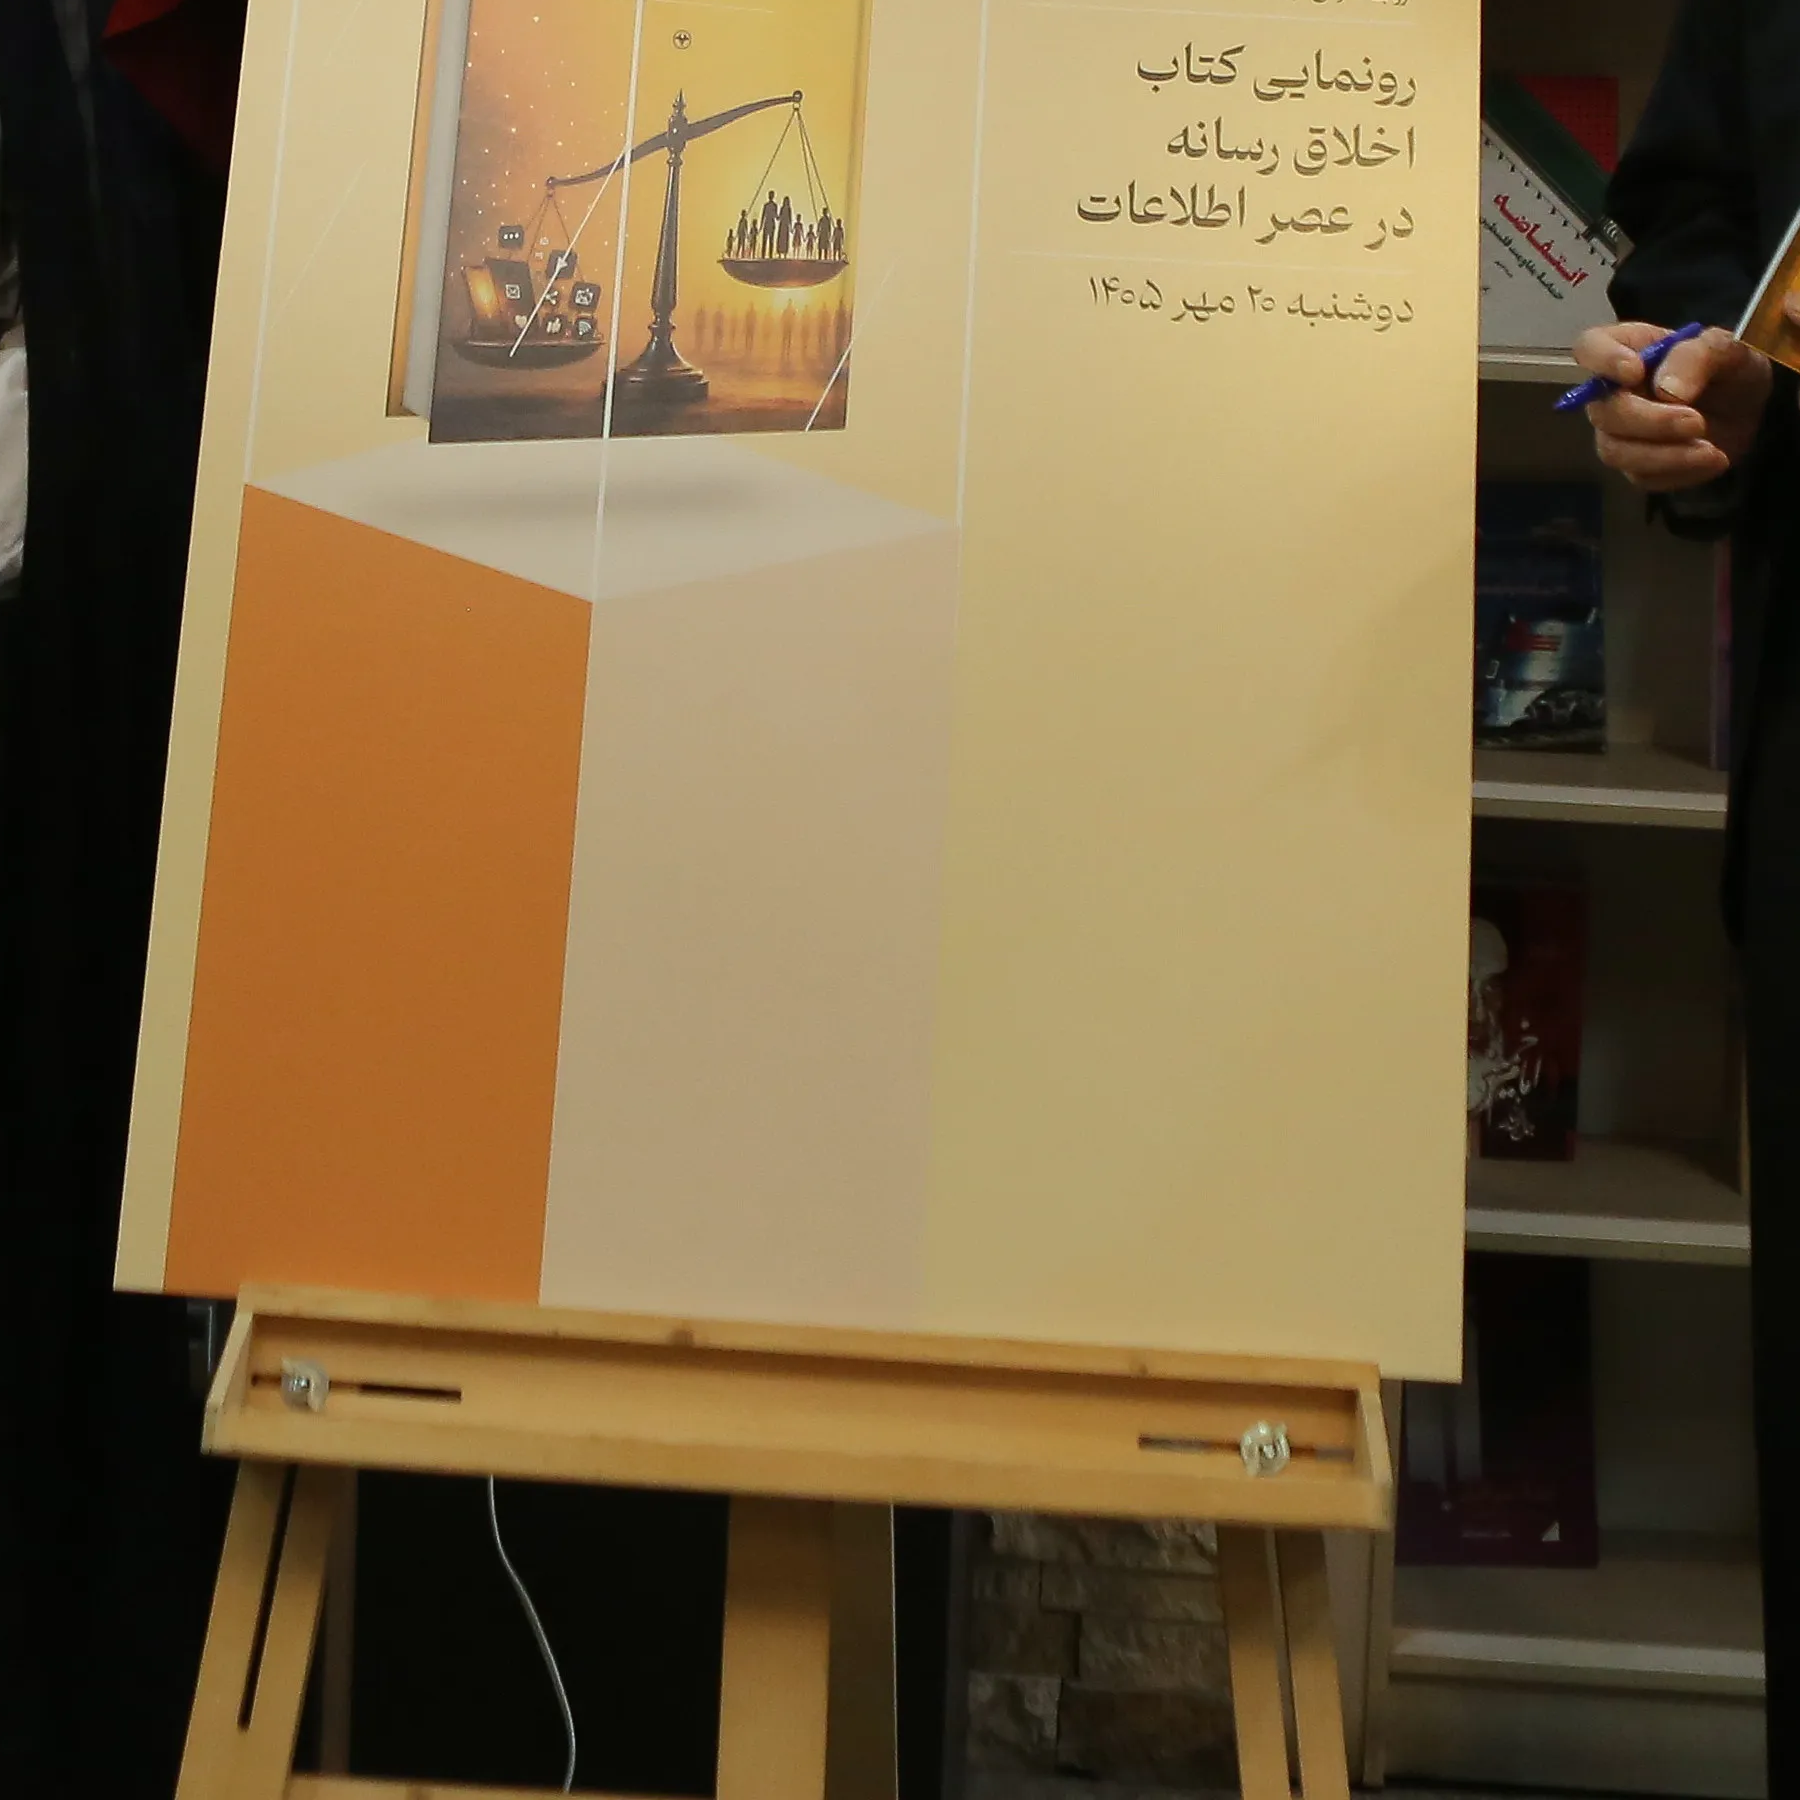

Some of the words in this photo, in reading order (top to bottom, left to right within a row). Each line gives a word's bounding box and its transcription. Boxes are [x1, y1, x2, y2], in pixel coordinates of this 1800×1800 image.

[1136, 41, 1247, 94] کتاب
[1253, 48, 1417, 107] رونمایی
[1166, 115, 1281, 176] رسانه
[1293, 123, 1416, 177] اخلاق
[1076, 179, 1246, 229] اطلاعات
[1253, 204, 1353, 246] عصر
[1363, 205, 1415, 251] در
[1493, 194, 1589, 288] انتفاضه
[1089, 275, 1164, 312] ۱۴۰۵
[1170, 291, 1236, 324] مهر
[1247, 285, 1277, 313] ۲۰
[1287, 292, 1415, 334] دوشنبه
